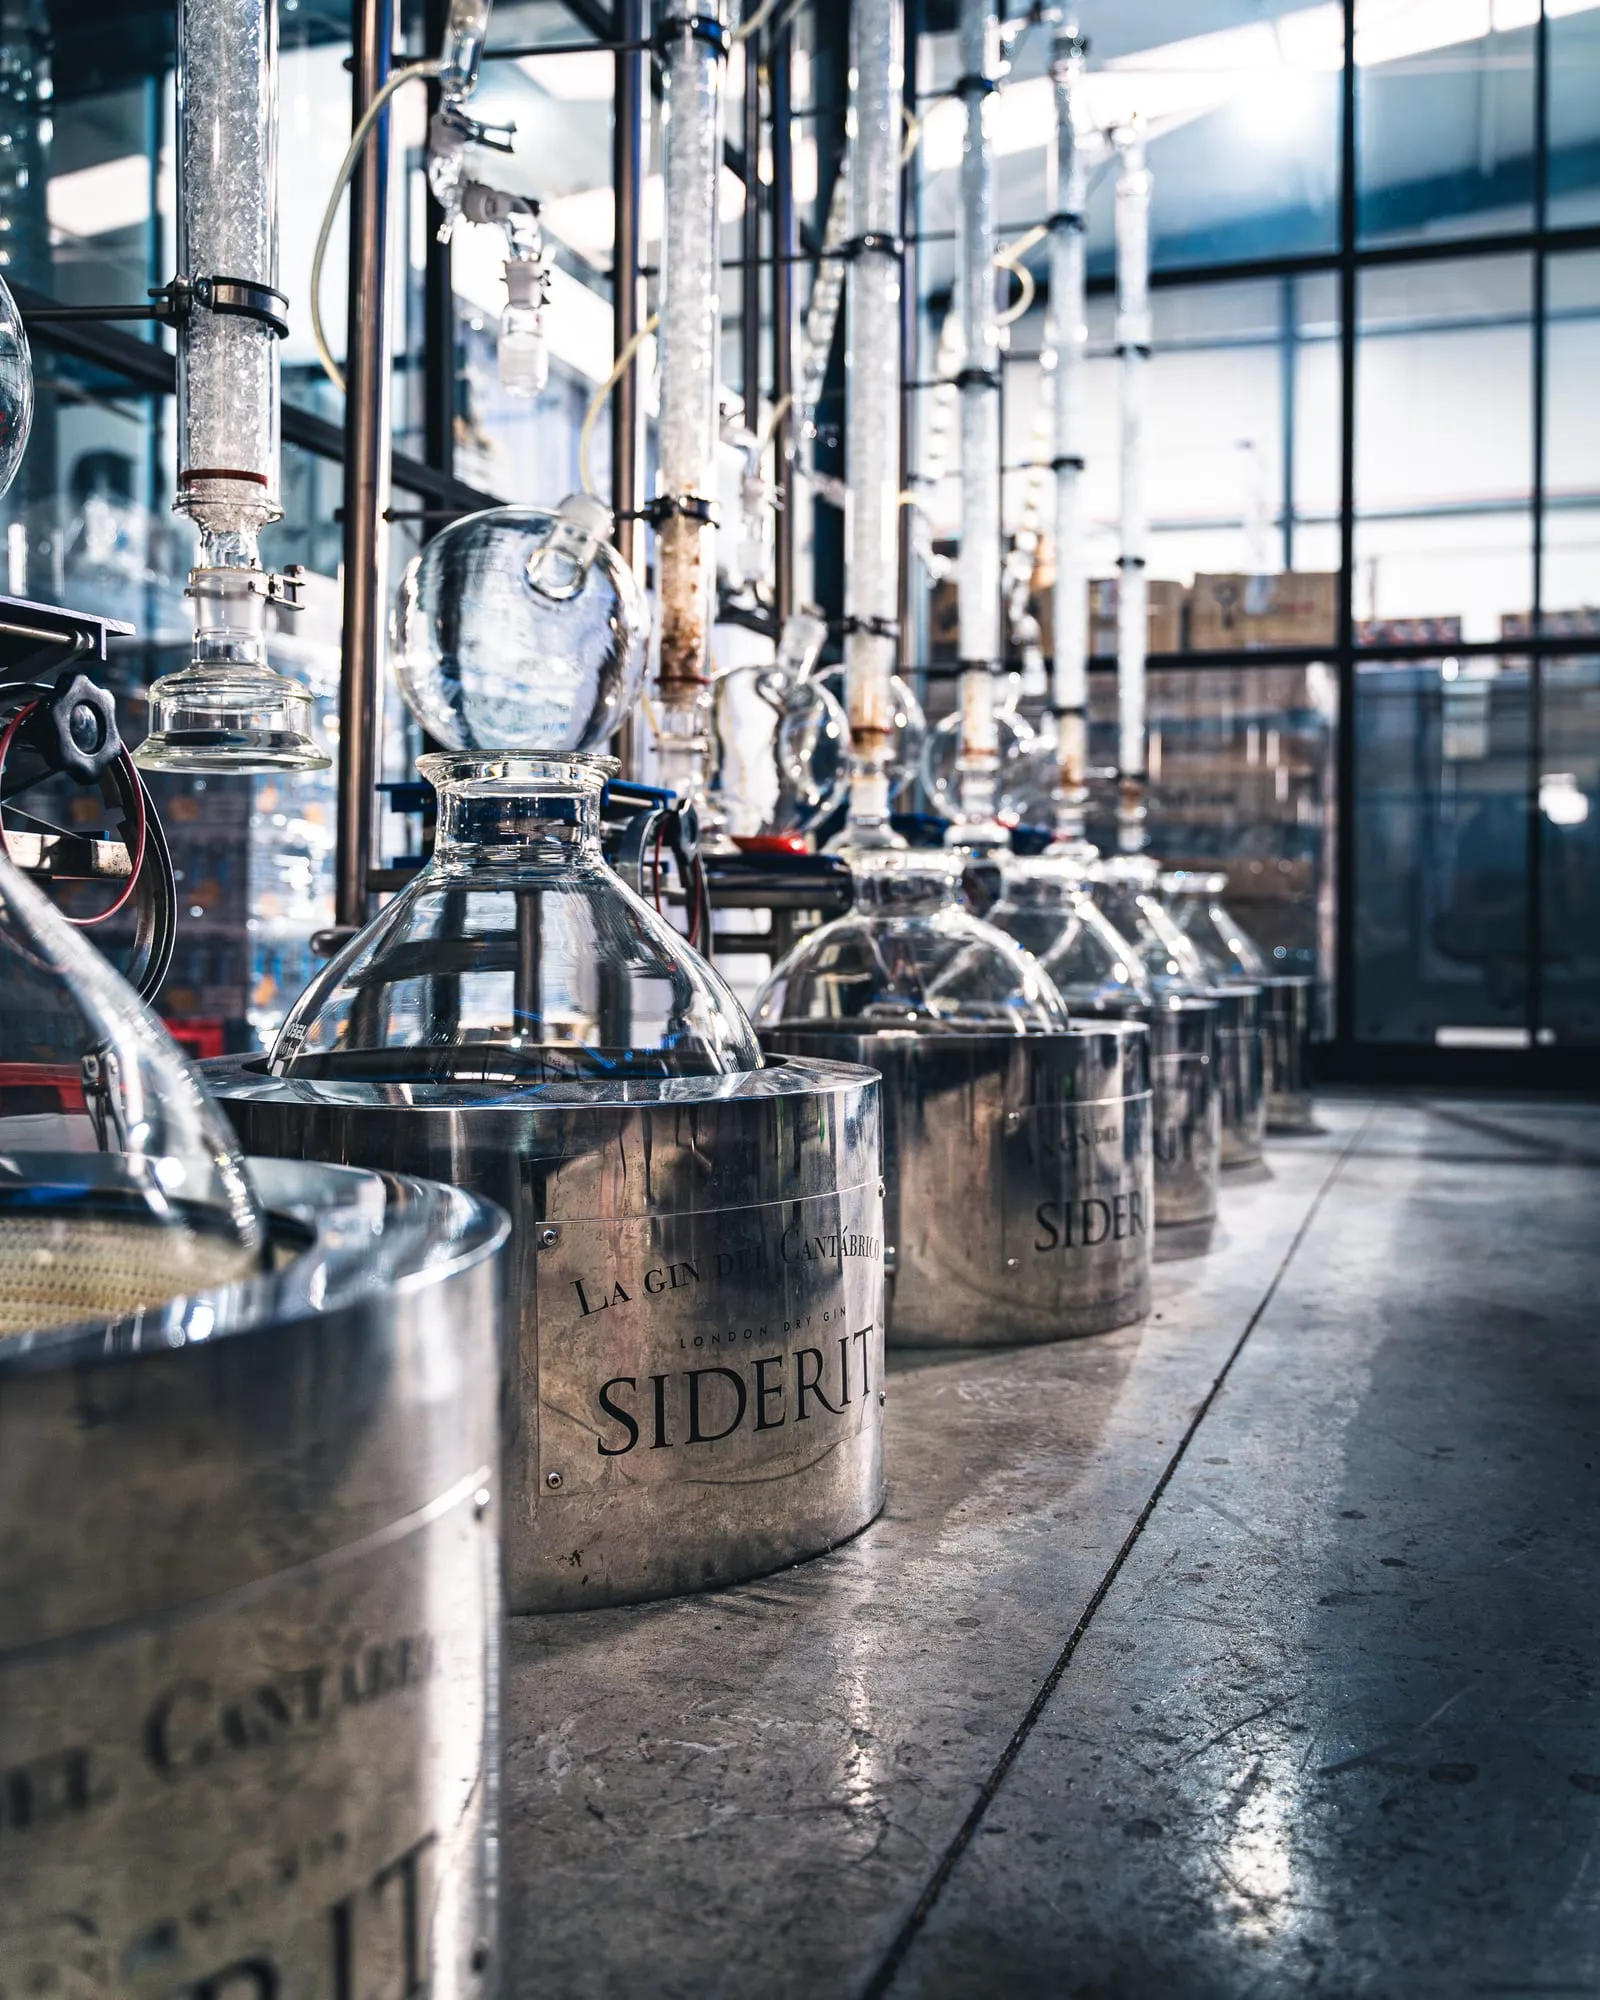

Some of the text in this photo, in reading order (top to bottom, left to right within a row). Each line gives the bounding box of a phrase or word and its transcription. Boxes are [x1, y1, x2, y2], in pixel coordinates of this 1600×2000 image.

[569, 1226, 880, 1317] LA GIN DEL CANTÁBRICO
[680, 1306, 847, 1349] LONDON DRY GIN
[597, 1325, 874, 1456] SIDERIT
